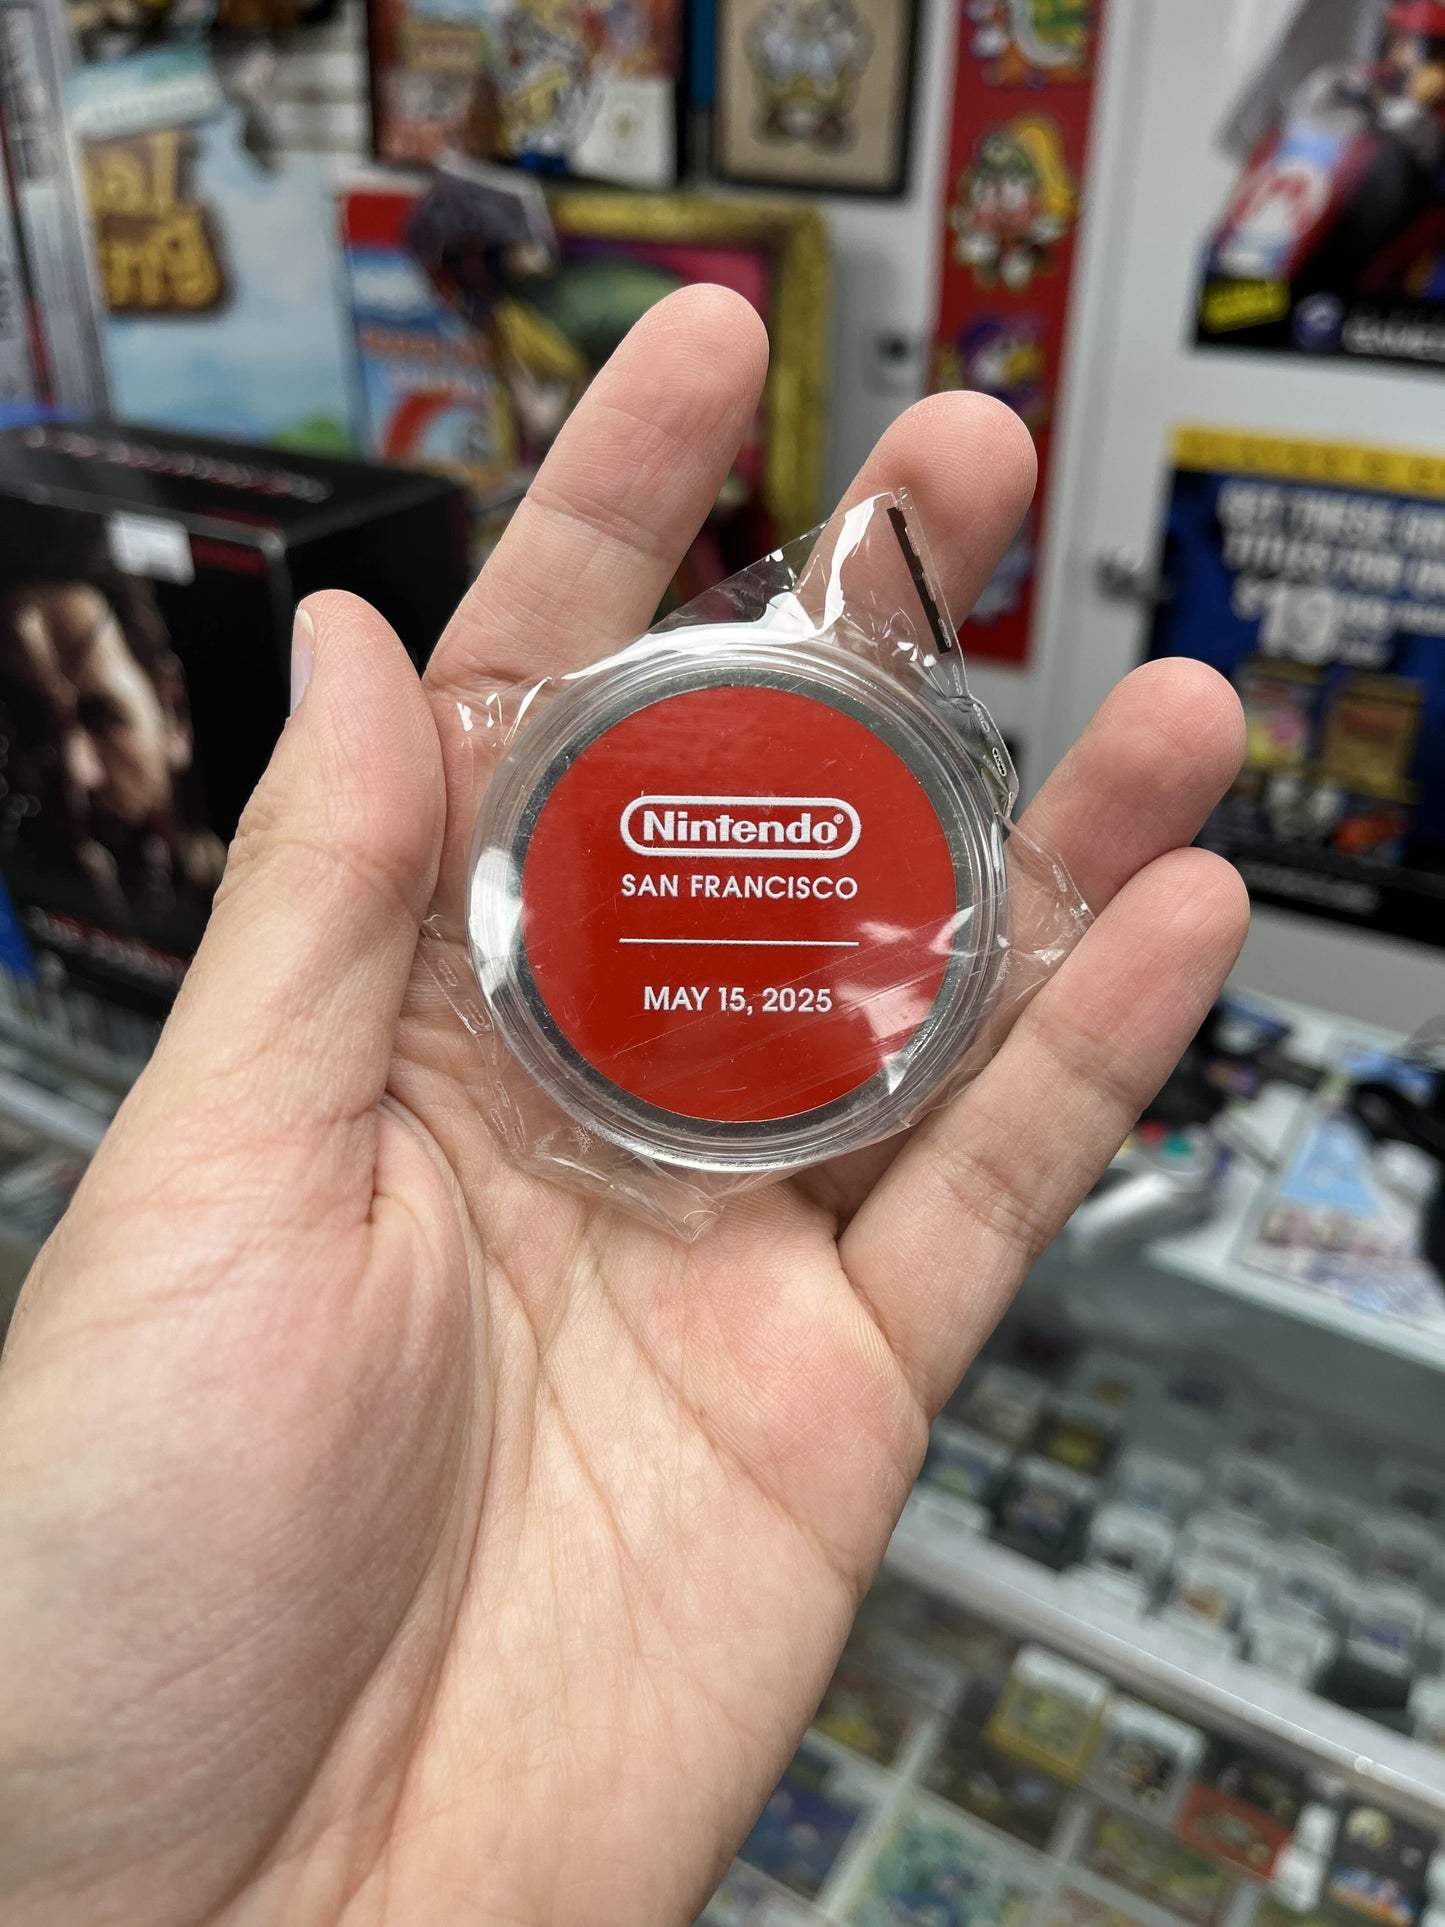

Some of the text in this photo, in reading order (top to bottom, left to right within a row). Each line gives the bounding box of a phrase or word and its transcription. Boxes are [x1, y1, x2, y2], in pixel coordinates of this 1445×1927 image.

[621, 873, 858, 900] SAN FRANCISCO
[644, 985, 833, 1016] MAY 15, 2025
